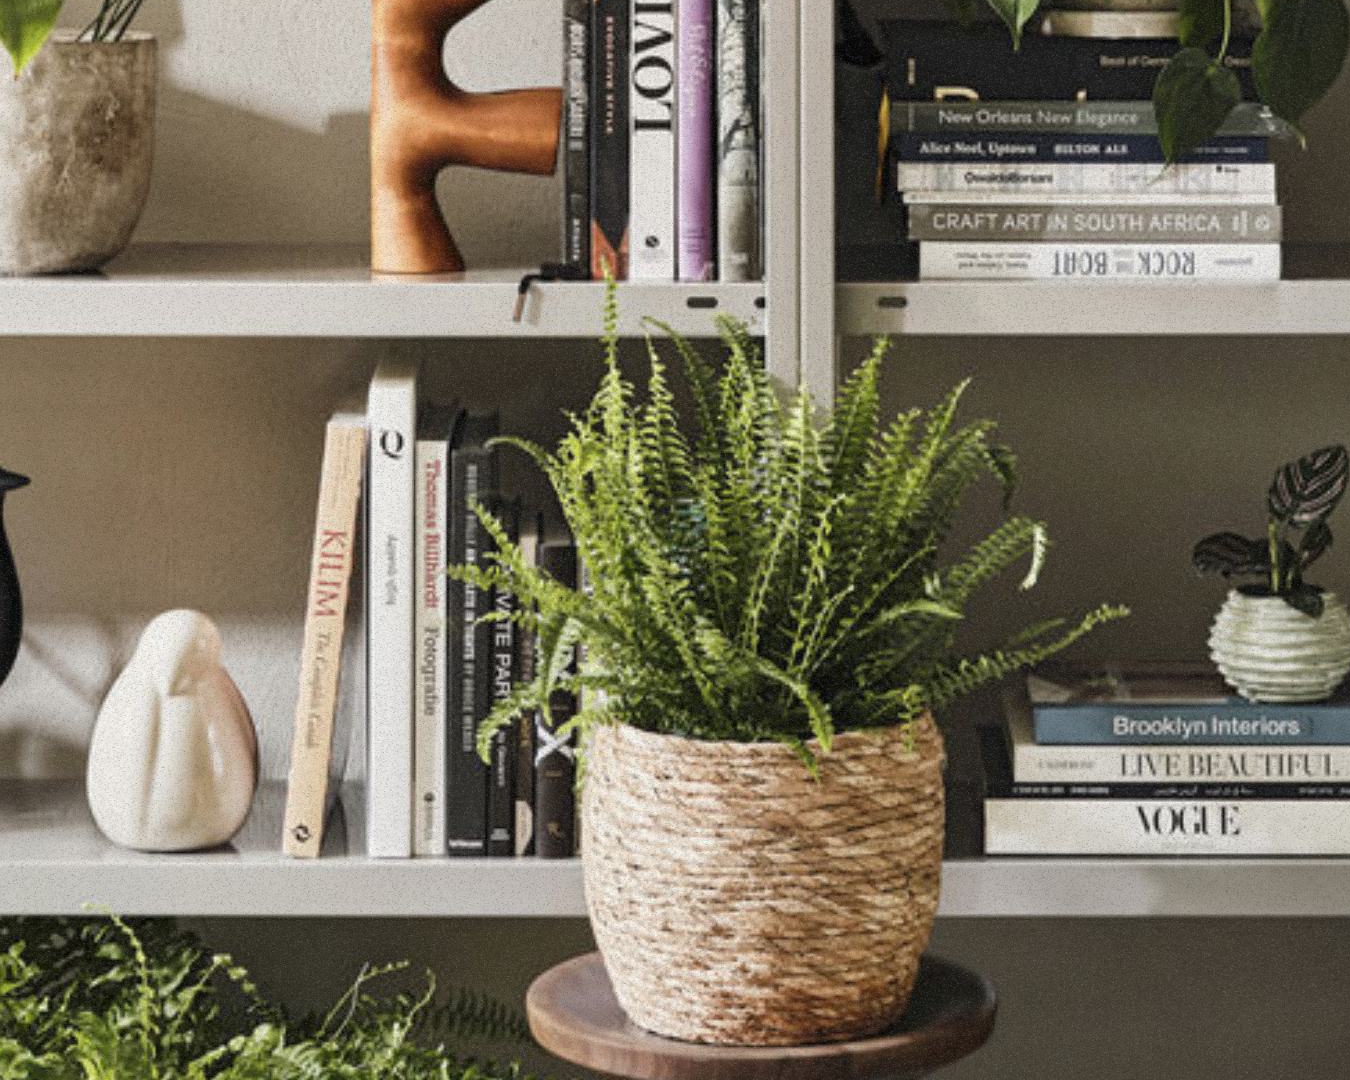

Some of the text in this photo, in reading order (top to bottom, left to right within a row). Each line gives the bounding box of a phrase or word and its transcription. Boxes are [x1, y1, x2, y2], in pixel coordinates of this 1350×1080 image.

[938, 108, 1139, 128] New Orleans New Elegance
[919, 141, 948, 155] Alice
[988, 142, 1037, 158] Uptown
[932, 213, 1221, 232] CRAFT ART IN SOUTH AFRICA
[1052, 249, 1109, 276] BOAT
[1138, 251, 1197, 276] ROCK
[312, 529, 348, 619] KILIM
[424, 459, 442, 716] Thomas Billhardt Fotografie
[1113, 716, 1300, 740] Brooklyn Interiors
[1121, 753, 1339, 778] LIVE BEAUTIFUL
[1137, 805, 1241, 836] VOGUE
